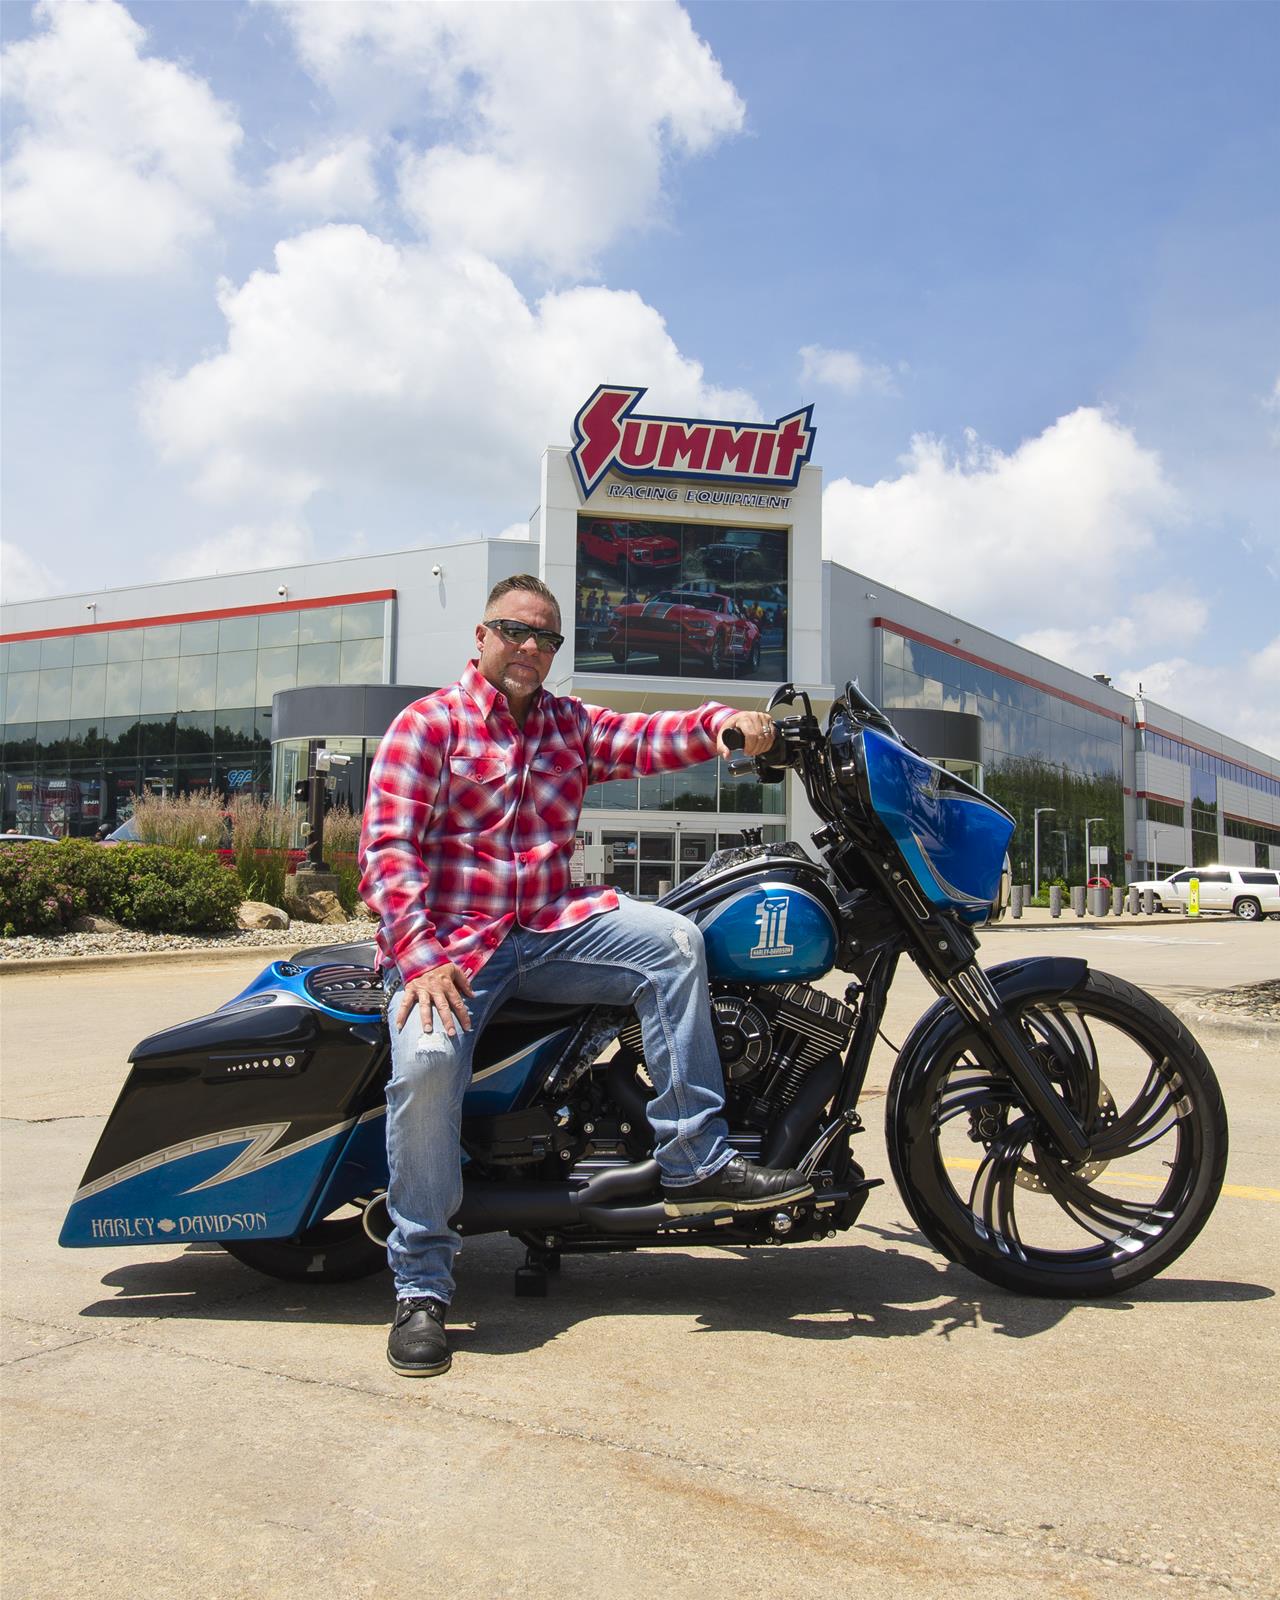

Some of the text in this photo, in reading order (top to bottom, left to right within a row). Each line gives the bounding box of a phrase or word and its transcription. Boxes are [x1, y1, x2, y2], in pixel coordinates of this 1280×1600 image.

[608, 484, 792, 509] RACING EQUIPMENT
[91, 1212, 267, 1238] HARLEY DAVIDSON
